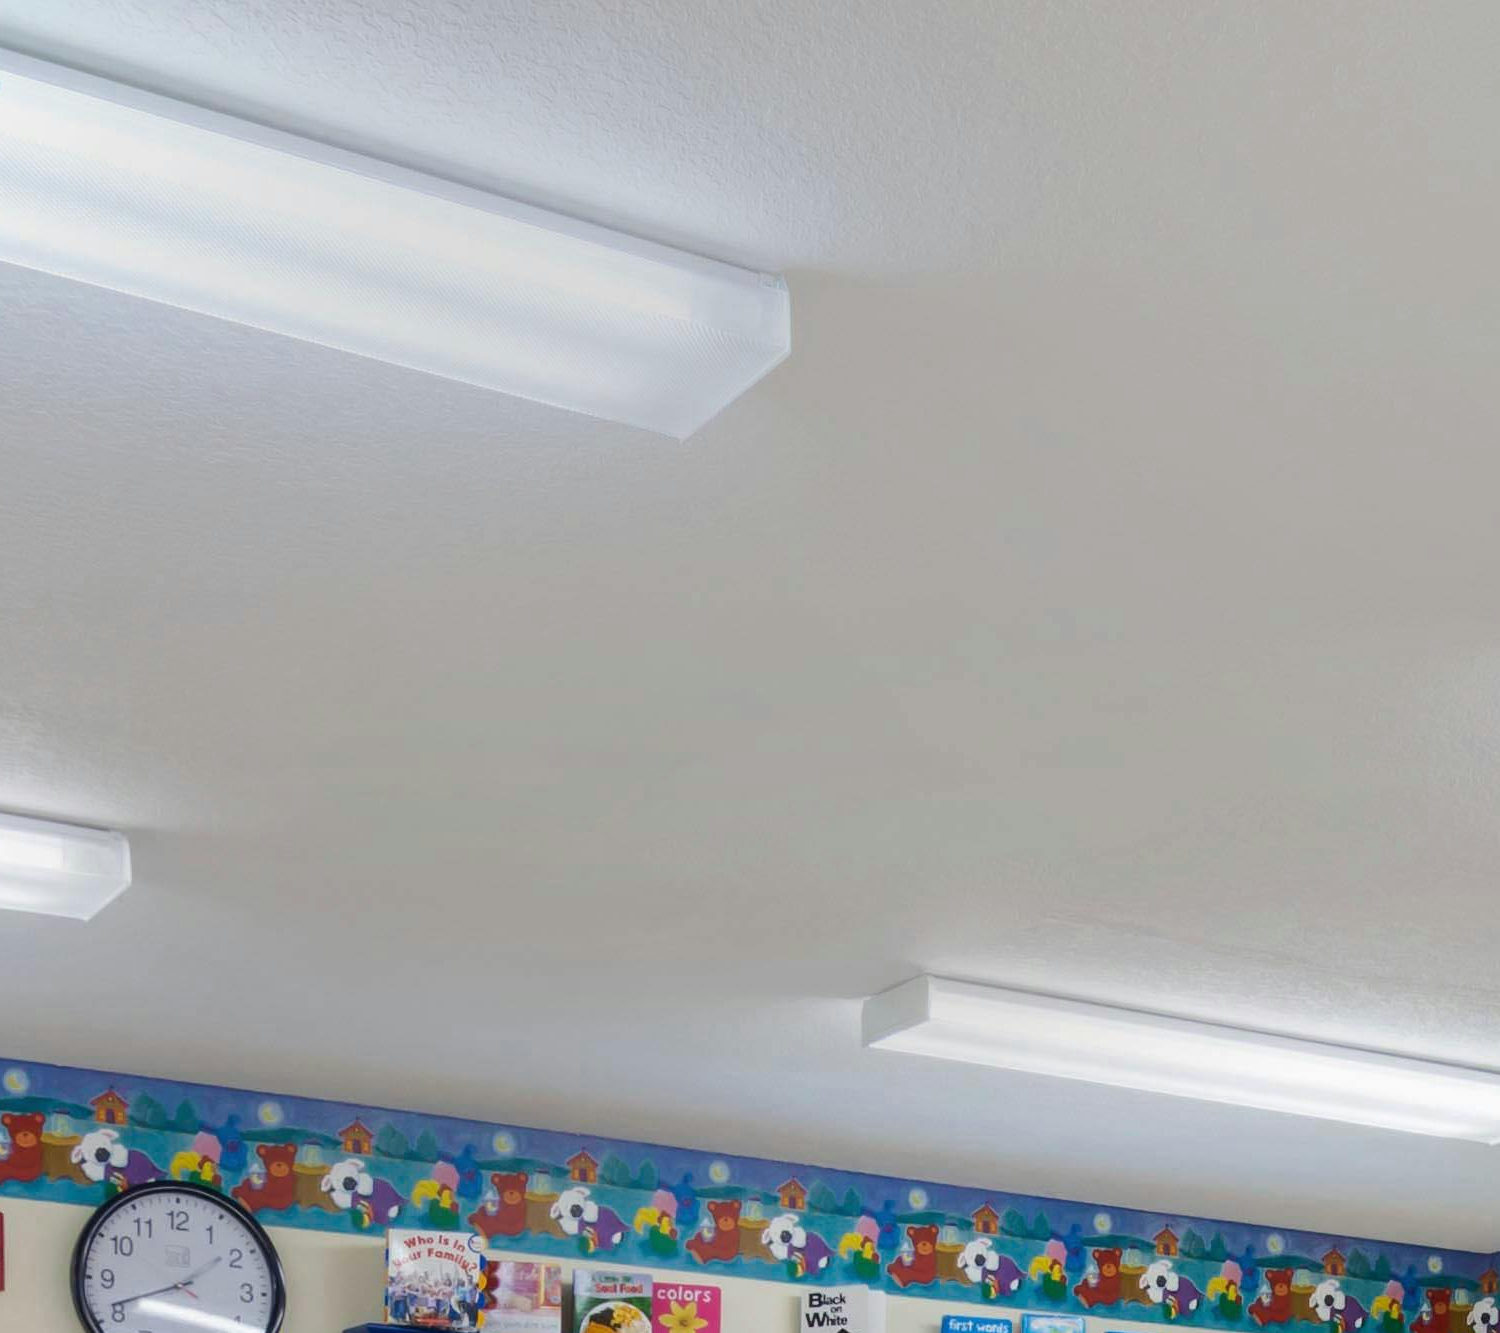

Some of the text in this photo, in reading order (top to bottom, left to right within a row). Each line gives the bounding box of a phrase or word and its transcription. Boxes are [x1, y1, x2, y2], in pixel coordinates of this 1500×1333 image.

[133, 1218, 153, 1239] 11
[166, 1211, 190, 1232] 12
[205, 1225, 213, 1245] 1
[404, 1235, 466, 1253] Who Is In
[110, 1235, 133, 1257] 10
[229, 1248, 243, 1269] 2
[392, 1248, 478, 1272] Your Family?
[100, 1268, 115, 1290] 9
[620, 1283, 644, 1295] Food
[240, 1283, 254, 1304] 3
[657, 1286, 712, 1303] colors
[809, 1293, 846, 1309] Black
[111, 1303, 126, 1323] 8
[805, 1312, 848, 1328] White
[948, 1318, 974, 1332] first
